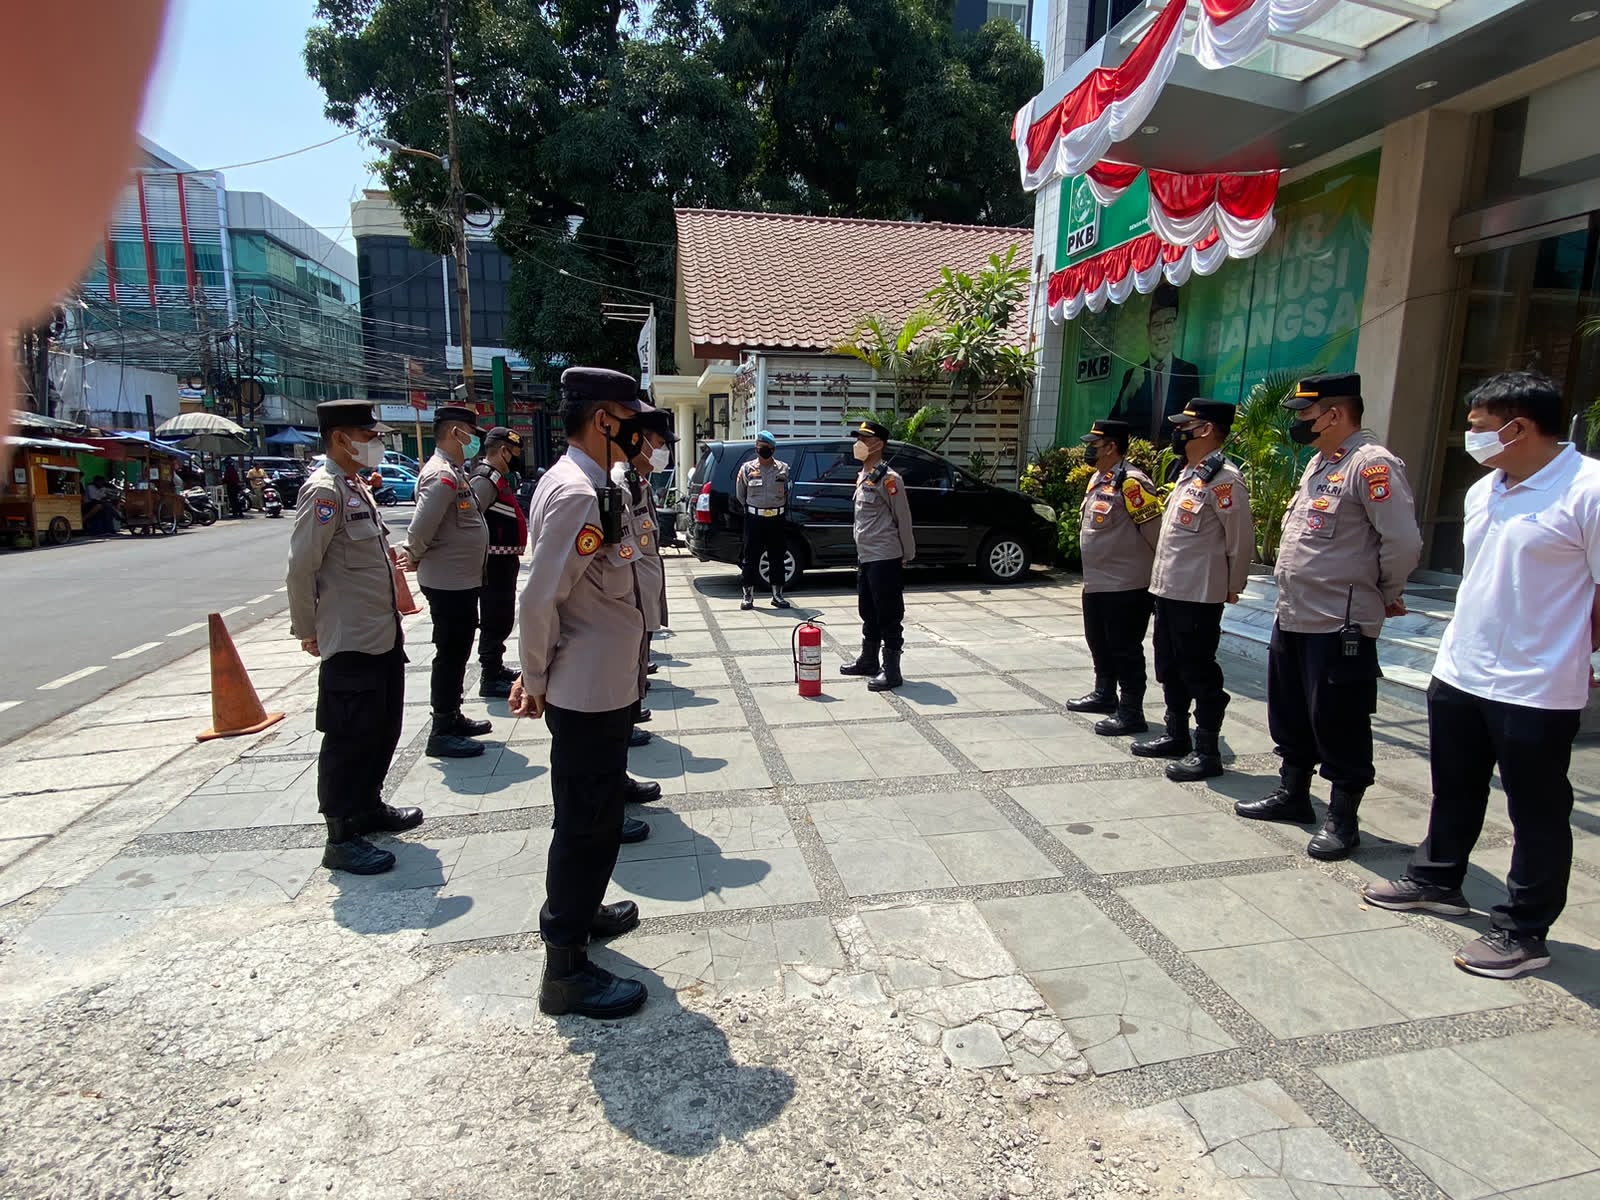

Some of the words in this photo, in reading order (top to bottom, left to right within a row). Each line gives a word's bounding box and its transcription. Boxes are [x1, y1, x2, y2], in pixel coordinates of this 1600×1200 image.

[1067, 225, 1094, 253] PKB
[1222, 248, 1350, 315] SOLUSI
[1208, 292, 1357, 354] BANGSA
[1077, 355, 1110, 379] PKB
[1186, 487, 1206, 499] POLRI
[1316, 484, 1342, 495] POLRI
